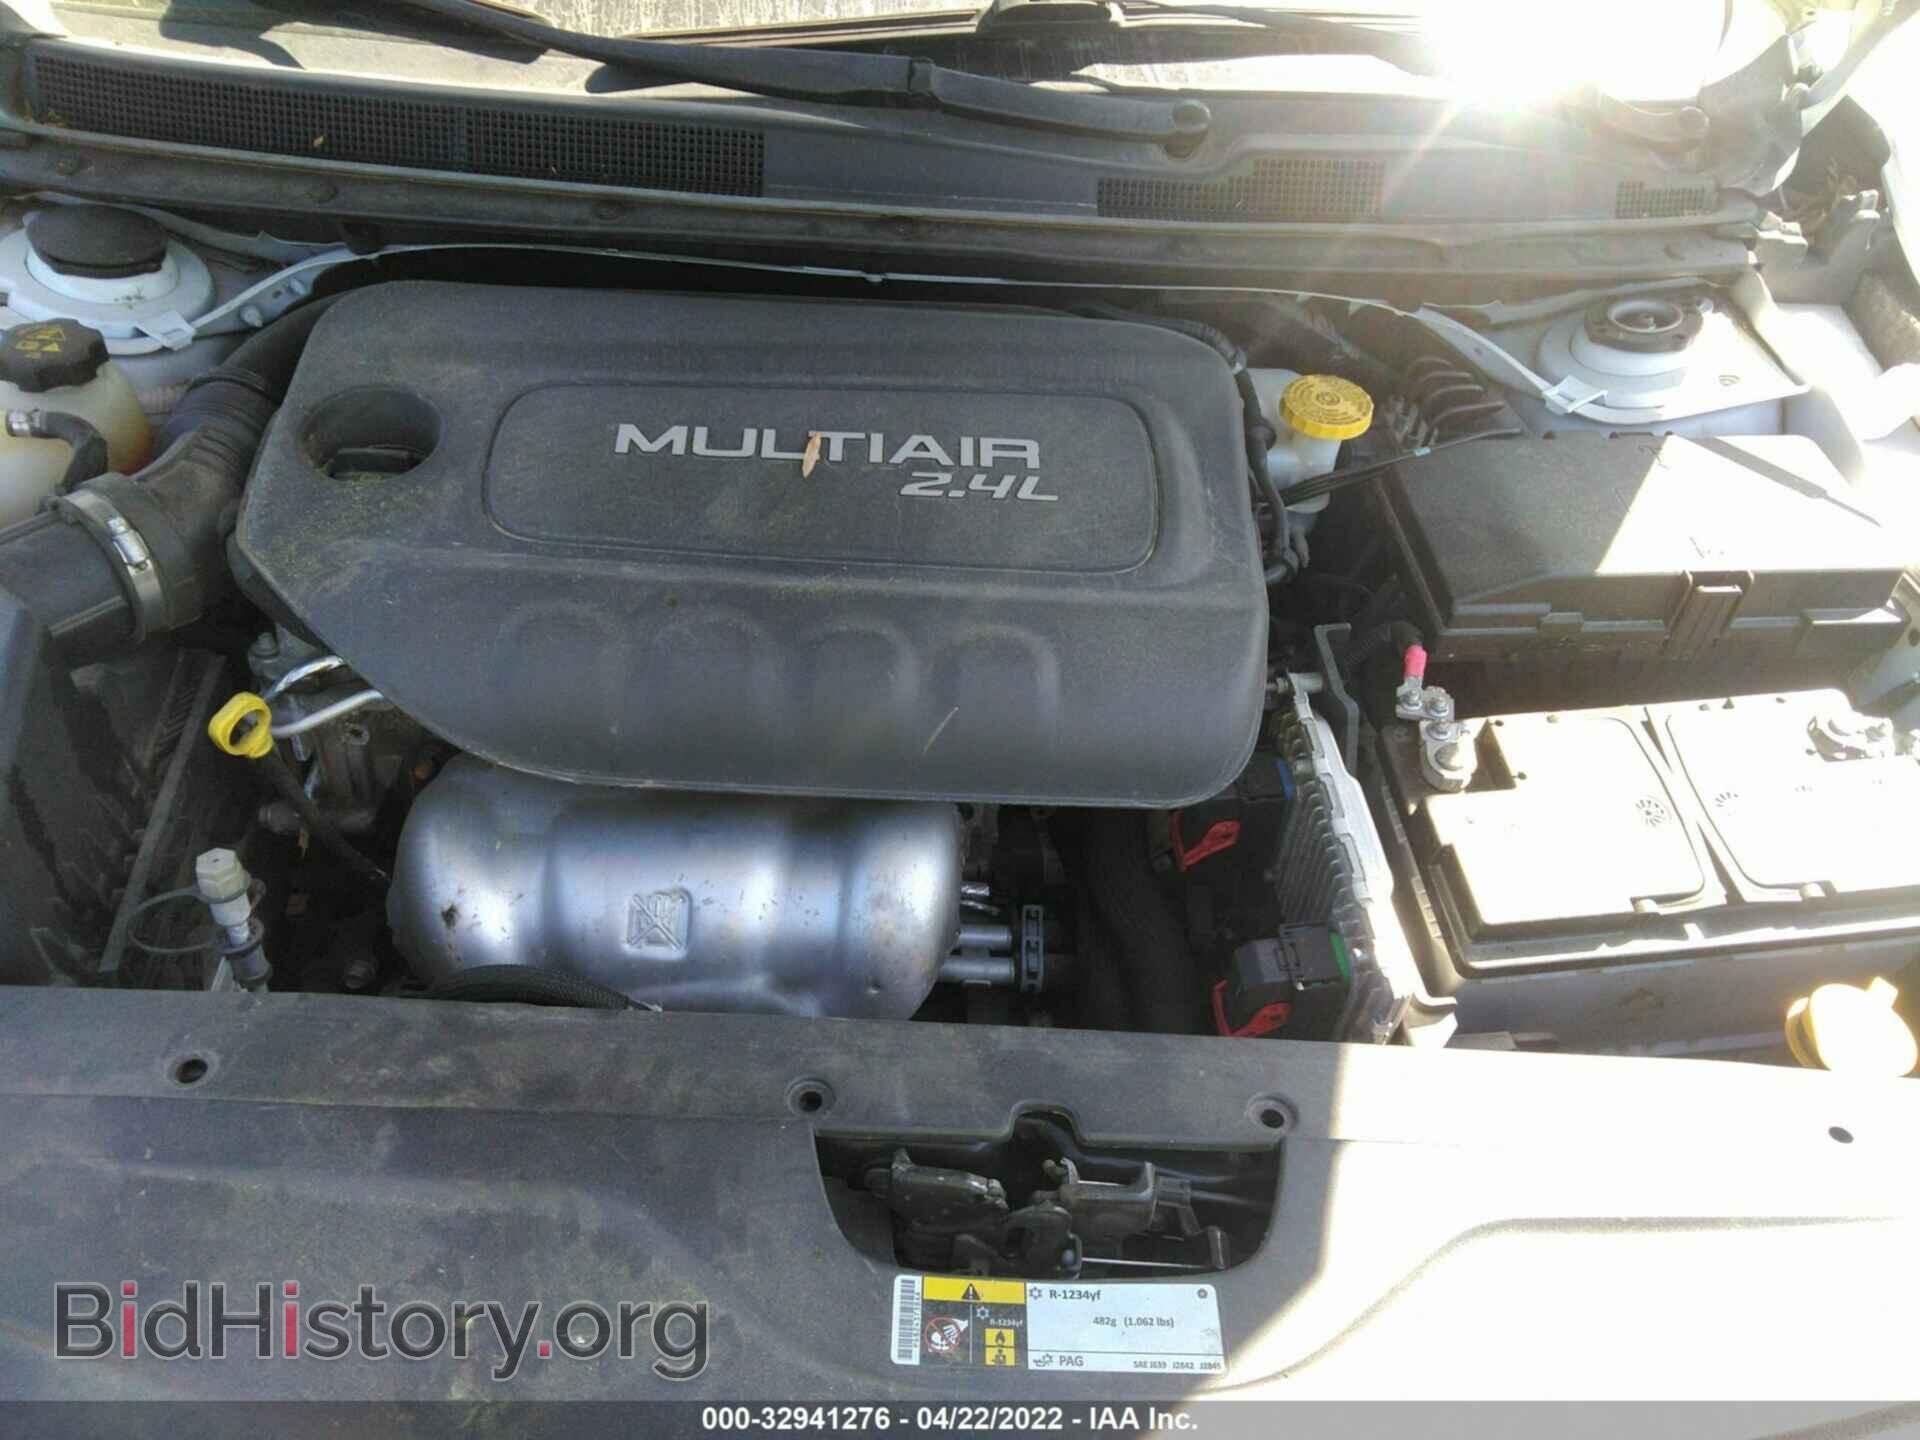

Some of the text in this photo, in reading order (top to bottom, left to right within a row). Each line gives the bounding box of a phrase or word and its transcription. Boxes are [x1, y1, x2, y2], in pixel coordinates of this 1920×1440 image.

[614, 423, 1040, 469] MULTIAIR
[899, 471, 1059, 501] 2.4L
[1049, 1289, 1101, 1301] R-1234yf
[1093, 1316, 1174, 1329] 482g (1.062 lbs)
[1059, 1355, 1084, 1368] PAG
